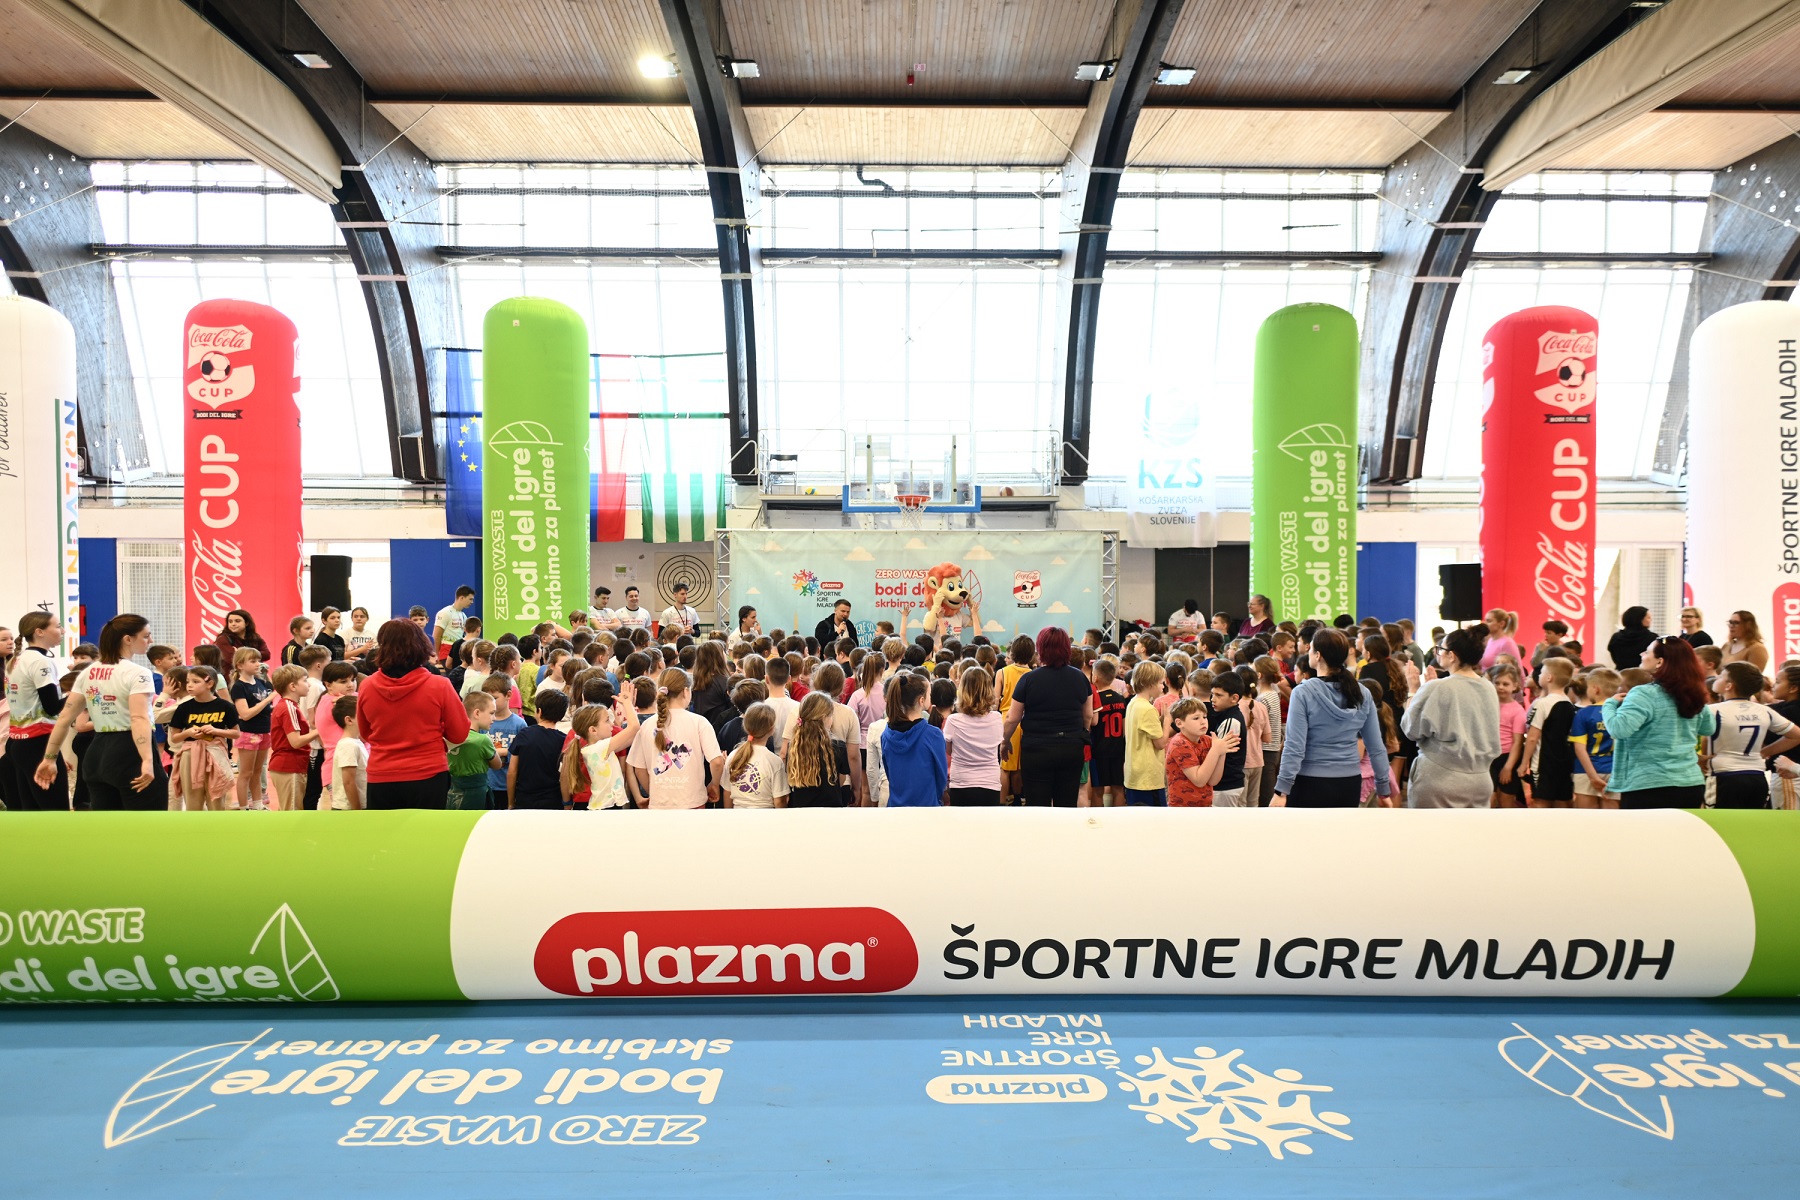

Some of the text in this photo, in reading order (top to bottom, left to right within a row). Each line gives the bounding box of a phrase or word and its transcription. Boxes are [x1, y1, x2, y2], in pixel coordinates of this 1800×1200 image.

[191, 329, 248, 348] Coca-Cola
[1542, 335, 1594, 354] Coca-Cola
[199, 388, 233, 397] CUP
[1778, 339, 1797, 421] MLADIH
[1554, 393, 1587, 402] CUP
[1780, 426, 1798, 472] IGRE
[200, 434, 240, 529] CUP
[1138, 458, 1203, 489] KZS
[1333, 450, 1349, 512] planet
[1551, 438, 1588, 531] CUP
[1139, 494, 1204, 504] KOŠARKARSKA
[1158, 506, 1188, 515] ZVEZA
[1150, 515, 1196, 525] SLOVENIJE
[1337, 518, 1348, 540] za
[1777, 478, 1799, 574] ŠPORTNE
[508, 447, 540, 621] bodi del igre
[538, 448, 563, 620] skrbimo za planet
[1303, 450, 1335, 620] bodi del igre
[491, 509, 509, 621] ZERO WASTE
[875, 569, 929, 579] ZERO WAST
[1280, 511, 1300, 621] ZERO WASTE
[875, 582, 907, 595] bodi
[875, 599, 916, 608] skrbimo
[89, 667, 115, 680] STAFF
[188, 712, 226, 724] PIKA!
[1102, 712, 1122, 737] 10
[1739, 725, 1760, 756] 7
[18, 908, 146, 945] WASTE
[943, 923, 1240, 980] ŠPORTNE
[1255, 937, 1403, 980] IGRE
[1415, 938, 1675, 981] MLADIH
[0, 954, 280, 995] di del igre
[963, 1014, 1103, 1029] MLADIH
[254, 1034, 734, 1060] skrbimo za planet
[1030, 1031, 1113, 1046] IGRE
[1555, 1028, 1728, 1055] planet
[941, 1049, 1121, 1070] ŠPORTNE
[210, 1059, 724, 1106] bodi del igre
[951, 1077, 1090, 1099] plazma
[1593, 1053, 1786, 1098] igre
[337, 1114, 707, 1147] ZERO WASTE
